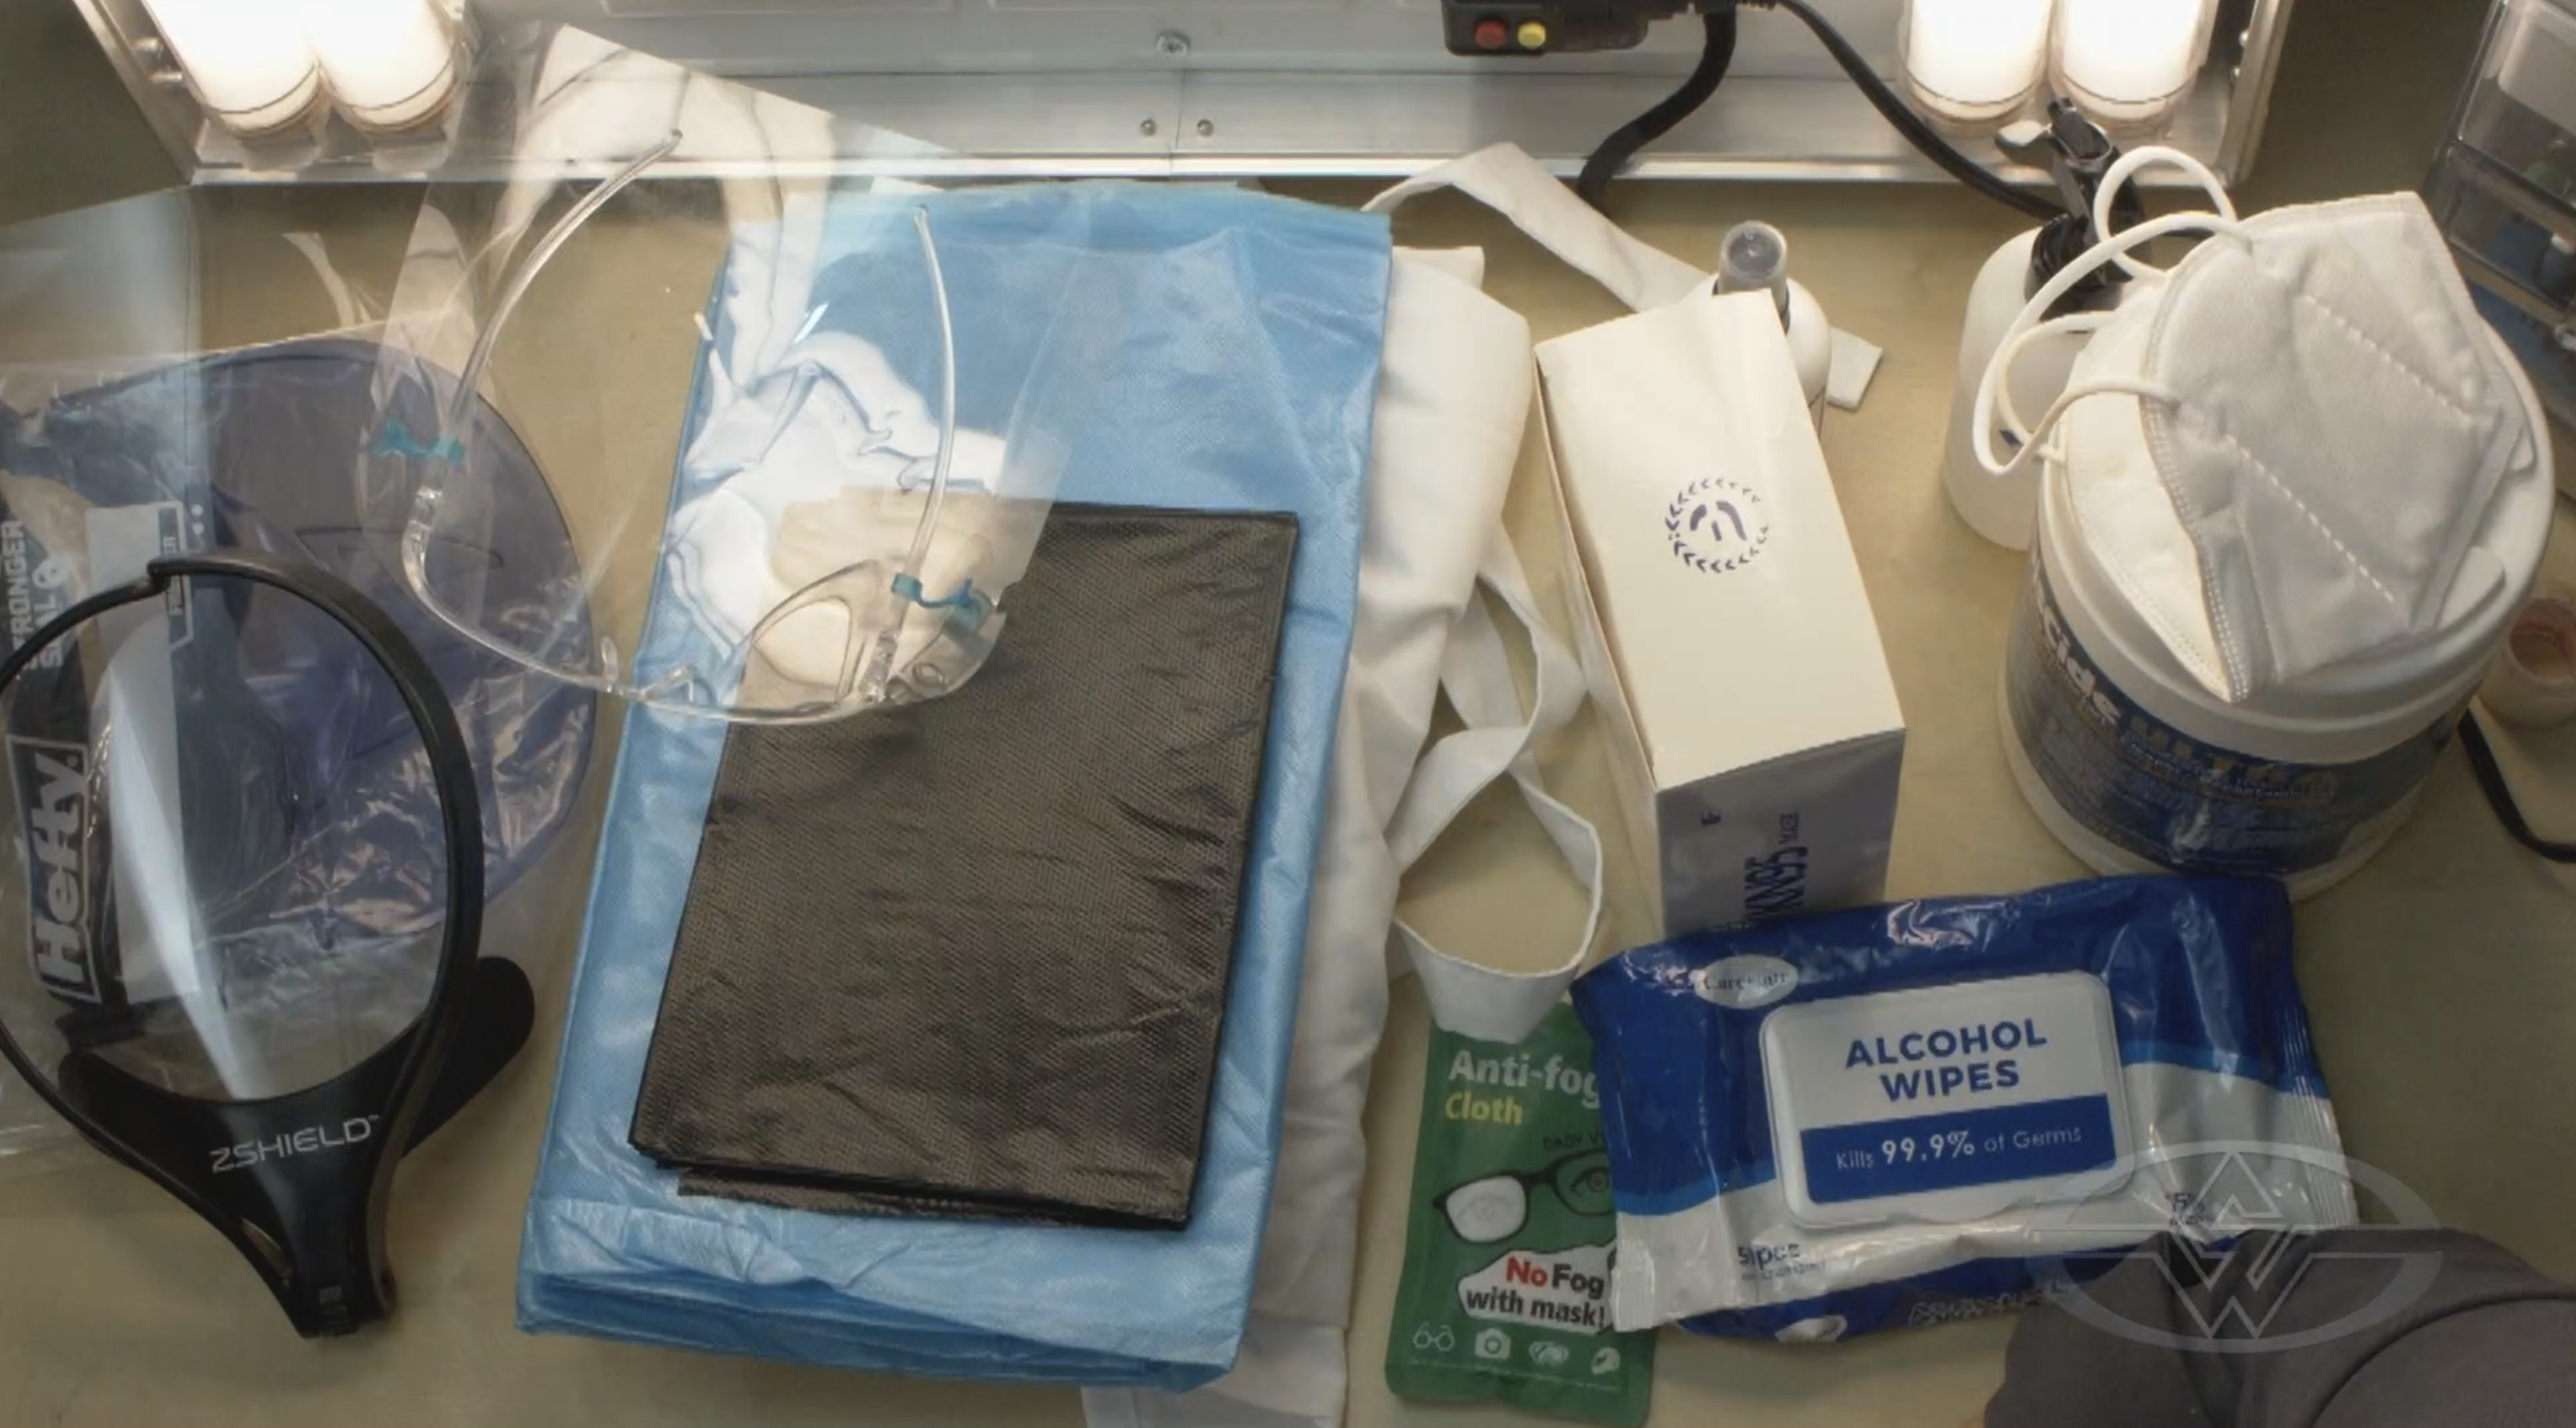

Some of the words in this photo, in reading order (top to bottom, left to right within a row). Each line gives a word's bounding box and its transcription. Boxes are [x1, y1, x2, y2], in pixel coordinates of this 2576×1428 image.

[0, 520, 37, 671] TRONGER
[34, 595, 64, 668] SAL
[1845, 1018, 2047, 1070] ALCOHOL
[1448, 1049, 1601, 1110] Anti-fog
[1880, 1059, 2019, 1102] WIPES
[1444, 1091, 1524, 1125] Cloth
[1836, 1151, 1874, 1171] Kills
[1882, 1130, 1975, 1165] 99.9%
[1984, 1133, 2005, 1152] of
[2013, 1125, 2082, 1149] Germs
[1505, 1256, 1548, 1288] No
[1552, 1264, 1605, 1299] Fog
[1465, 1286, 1524, 1316] with
[1529, 1295, 1606, 1329] mask!
